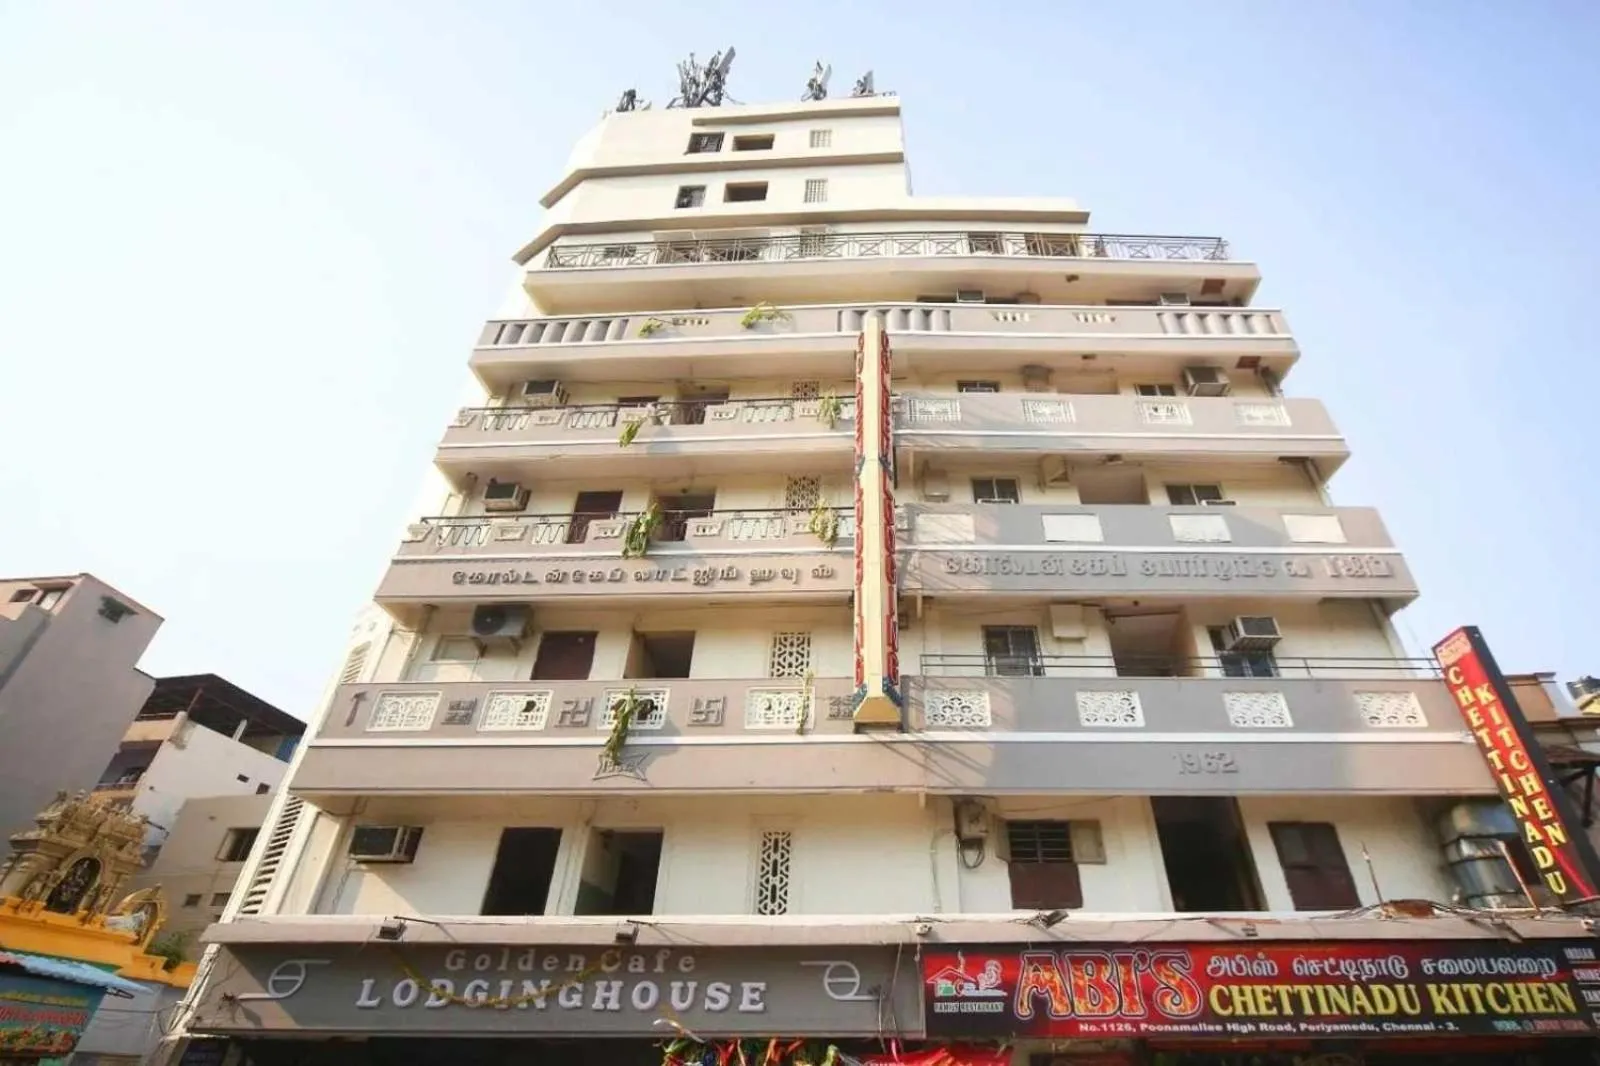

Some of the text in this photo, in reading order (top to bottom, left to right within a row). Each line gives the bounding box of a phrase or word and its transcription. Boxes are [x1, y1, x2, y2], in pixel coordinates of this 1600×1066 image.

[1447, 666, 1567, 895] CHETTINADU
[1475, 683, 1568, 846] KITCHEN
[444, 948, 696, 973] Golden Cafe
[1206, 952, 1558, 981] அபிஸ் செட்டிநாடு சமையலறை
[354, 978, 769, 1012] LODGINGHOUSE
[1014, 949, 1203, 1021] ABI'S
[1209, 982, 1578, 1017] CHETTINADU KITCHEN
[1226, 1022, 1256, 1034] High
[1259, 1022, 1297, 1033] Road,
[1382, 1021, 1435, 1032] Chennai
